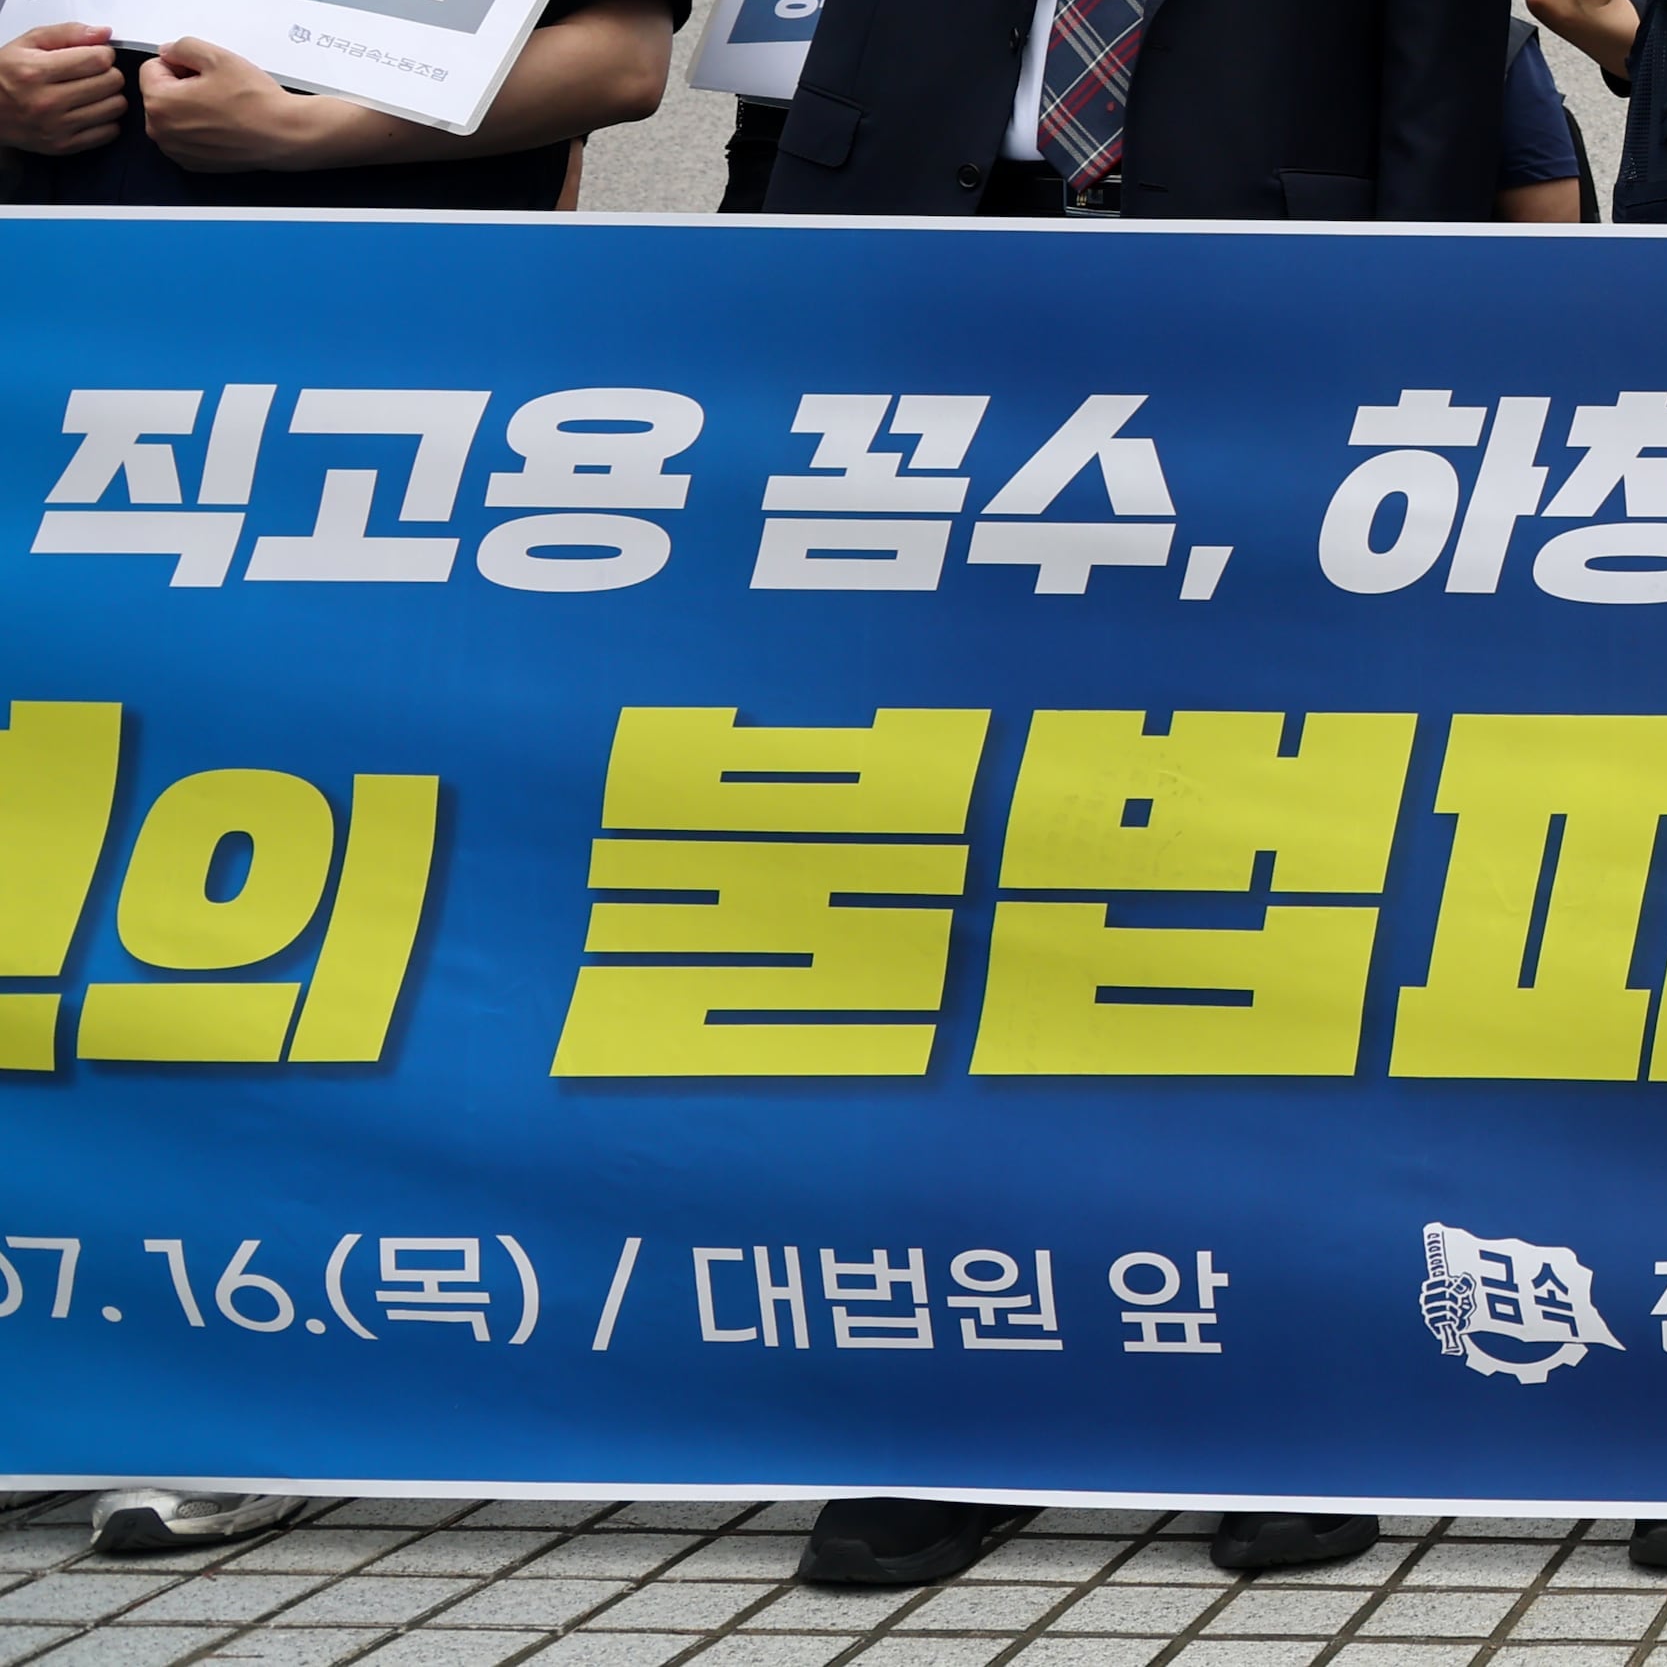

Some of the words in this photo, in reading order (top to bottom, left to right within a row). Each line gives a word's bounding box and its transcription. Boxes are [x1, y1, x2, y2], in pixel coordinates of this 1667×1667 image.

[316, 33, 448, 82] 전국금속노동조합
[30, 383, 705, 593] 직고용
[749, 393, 1234, 601] 꼼수,
[592, 1237, 642, 1351] /
[692, 1245, 1063, 1351] 대법원
[1108, 1250, 1229, 1353] 앞
